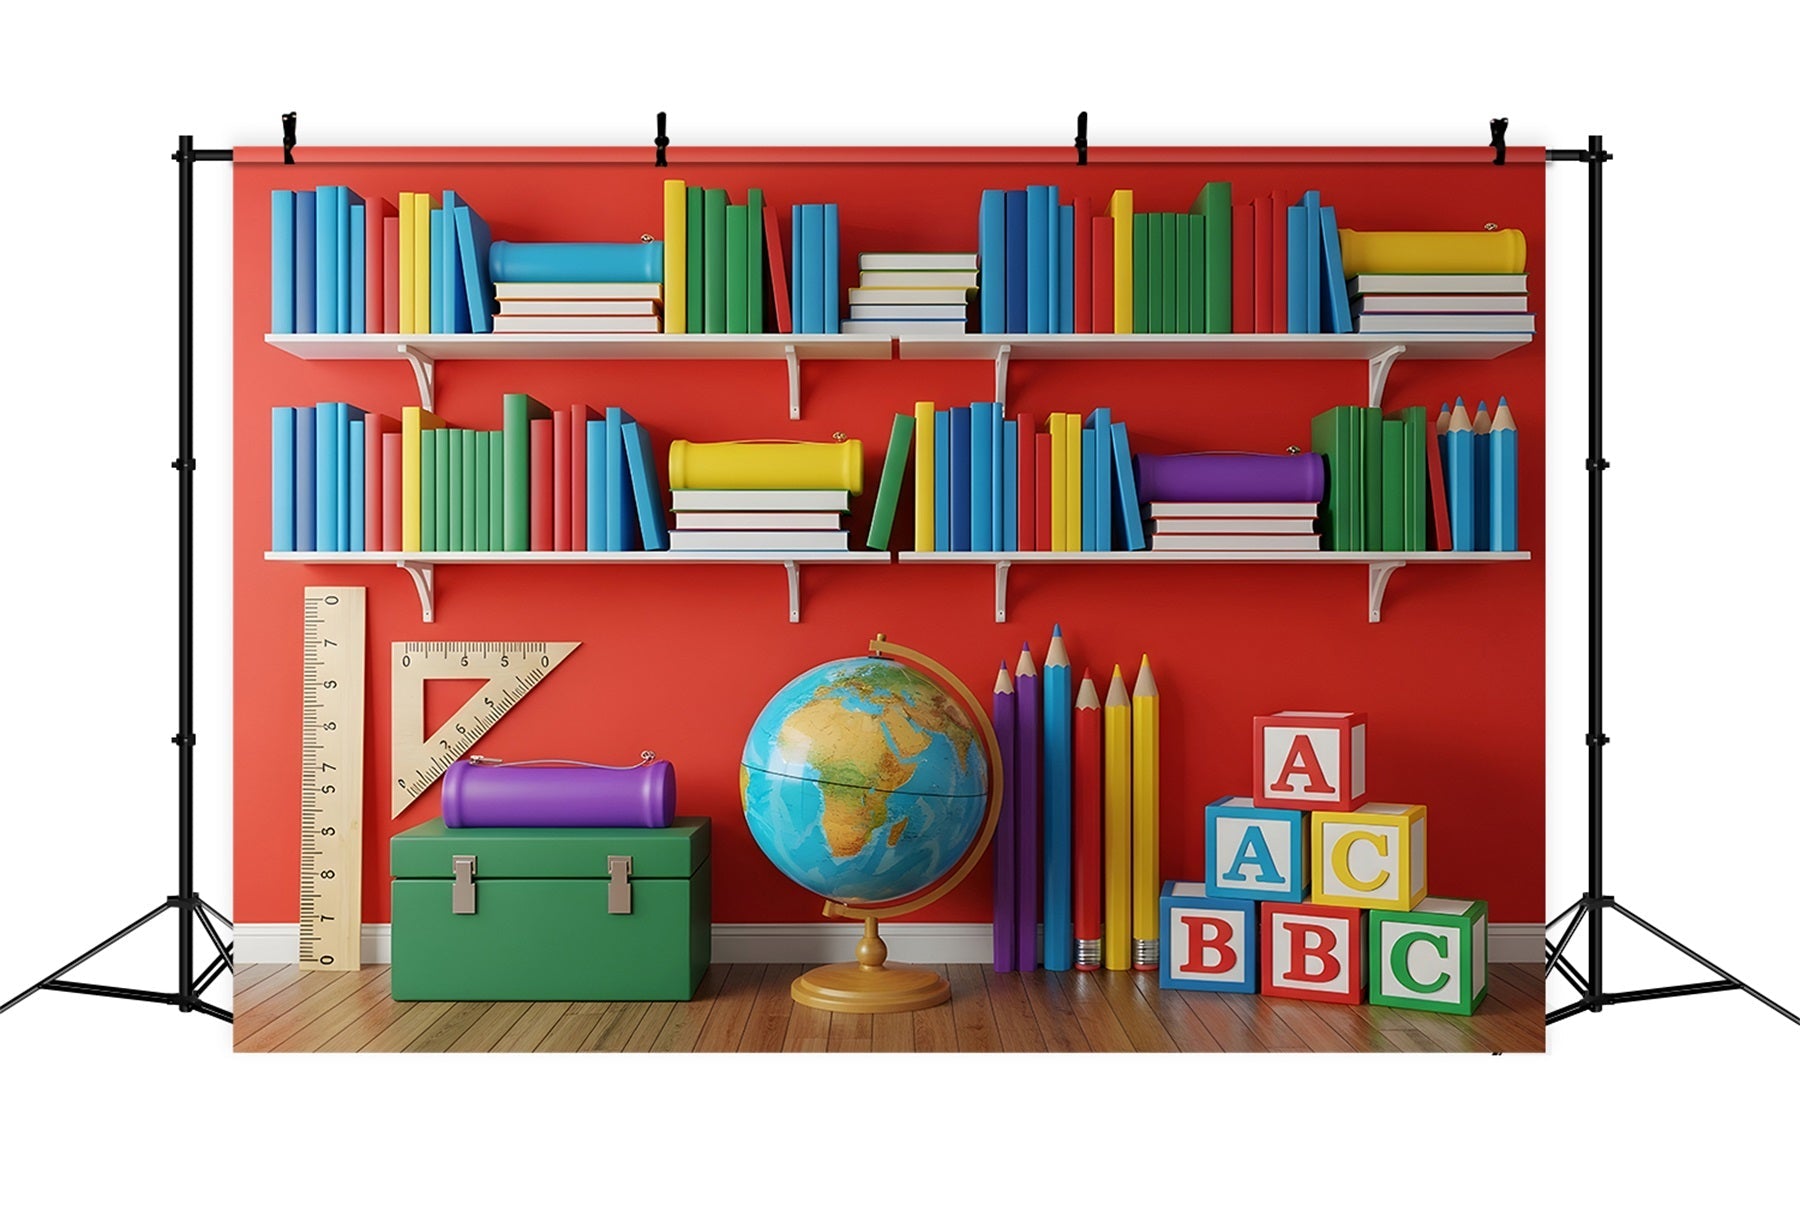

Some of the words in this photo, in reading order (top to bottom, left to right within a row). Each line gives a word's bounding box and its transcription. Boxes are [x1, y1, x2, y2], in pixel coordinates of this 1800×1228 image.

[324, 595, 340, 606] 0
[324, 638, 338, 648] 7
[402, 655, 411, 668] 0
[540, 655, 550, 669] 0
[322, 762, 337, 773] 7
[1270, 734, 1336, 794] A
[1222, 825, 1286, 884] A
[1331, 830, 1391, 893] C
[319, 869, 336, 880] 8
[319, 954, 335, 966] 0
[1179, 915, 1237, 975] B
[1282, 921, 1341, 984] B
[1390, 931, 1451, 994] C
